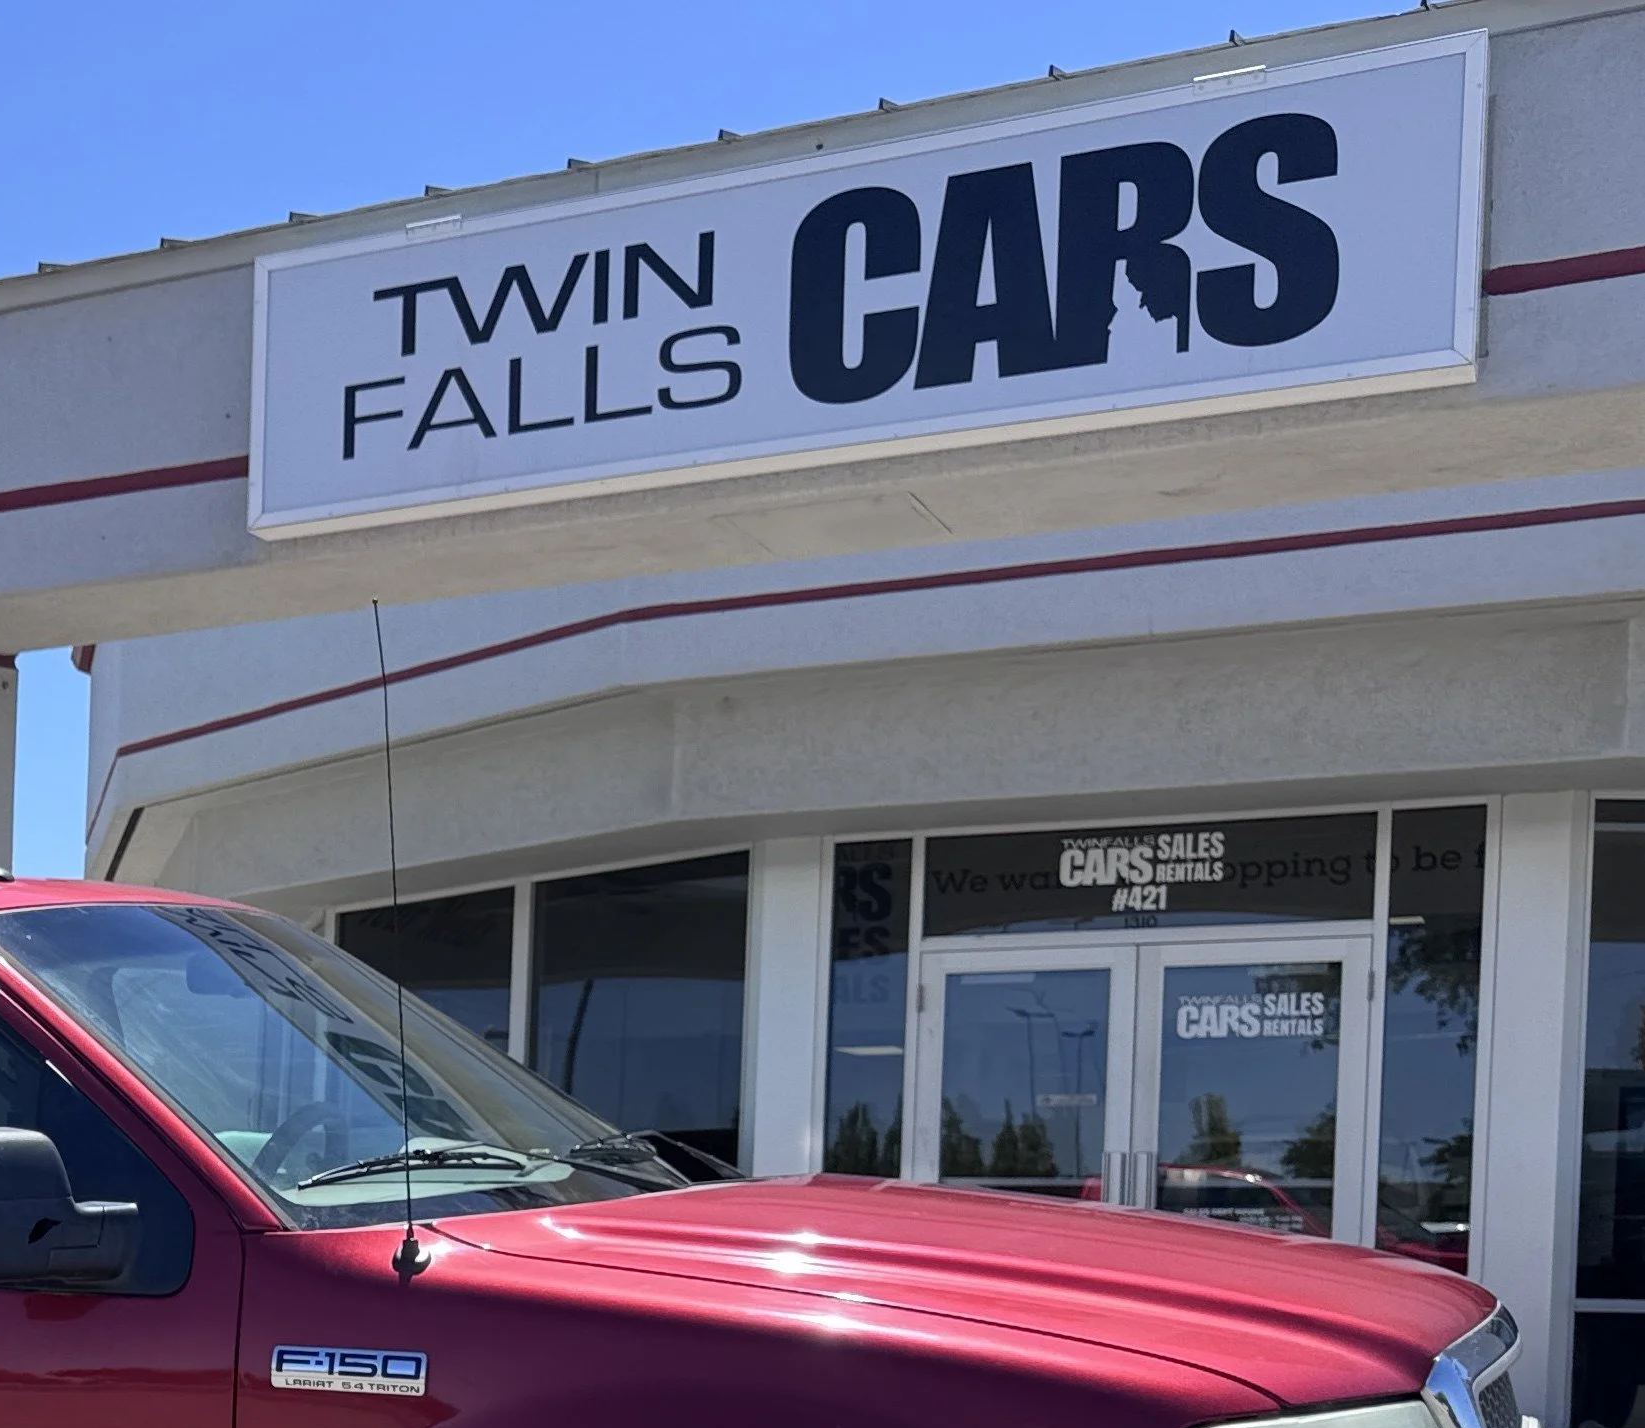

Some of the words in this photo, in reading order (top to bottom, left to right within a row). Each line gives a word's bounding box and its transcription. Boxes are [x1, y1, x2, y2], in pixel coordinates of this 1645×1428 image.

[789, 113, 1340, 405] CARS
[374, 231, 714, 356] TWIN
[343, 326, 742, 460] FALLS
[1157, 832, 1225, 860] SALES
[933, 869, 988, 895] We
[1224, 851, 1351, 889] opping
[1412, 846, 1462, 872] be
[1059, 847, 1154, 888] CARS
[1156, 860, 1225, 883] RENTALS
[1112, 885, 1168, 912] #421
[1263, 992, 1325, 1016] SALES
[1176, 1003, 1261, 1039] CARS
[1262, 1018, 1324, 1037] RENTALS
[275, 1350, 422, 1380] F-150
[285, 1378, 334, 1389] LARIAT
[367, 1383, 420, 1394] TRITON
